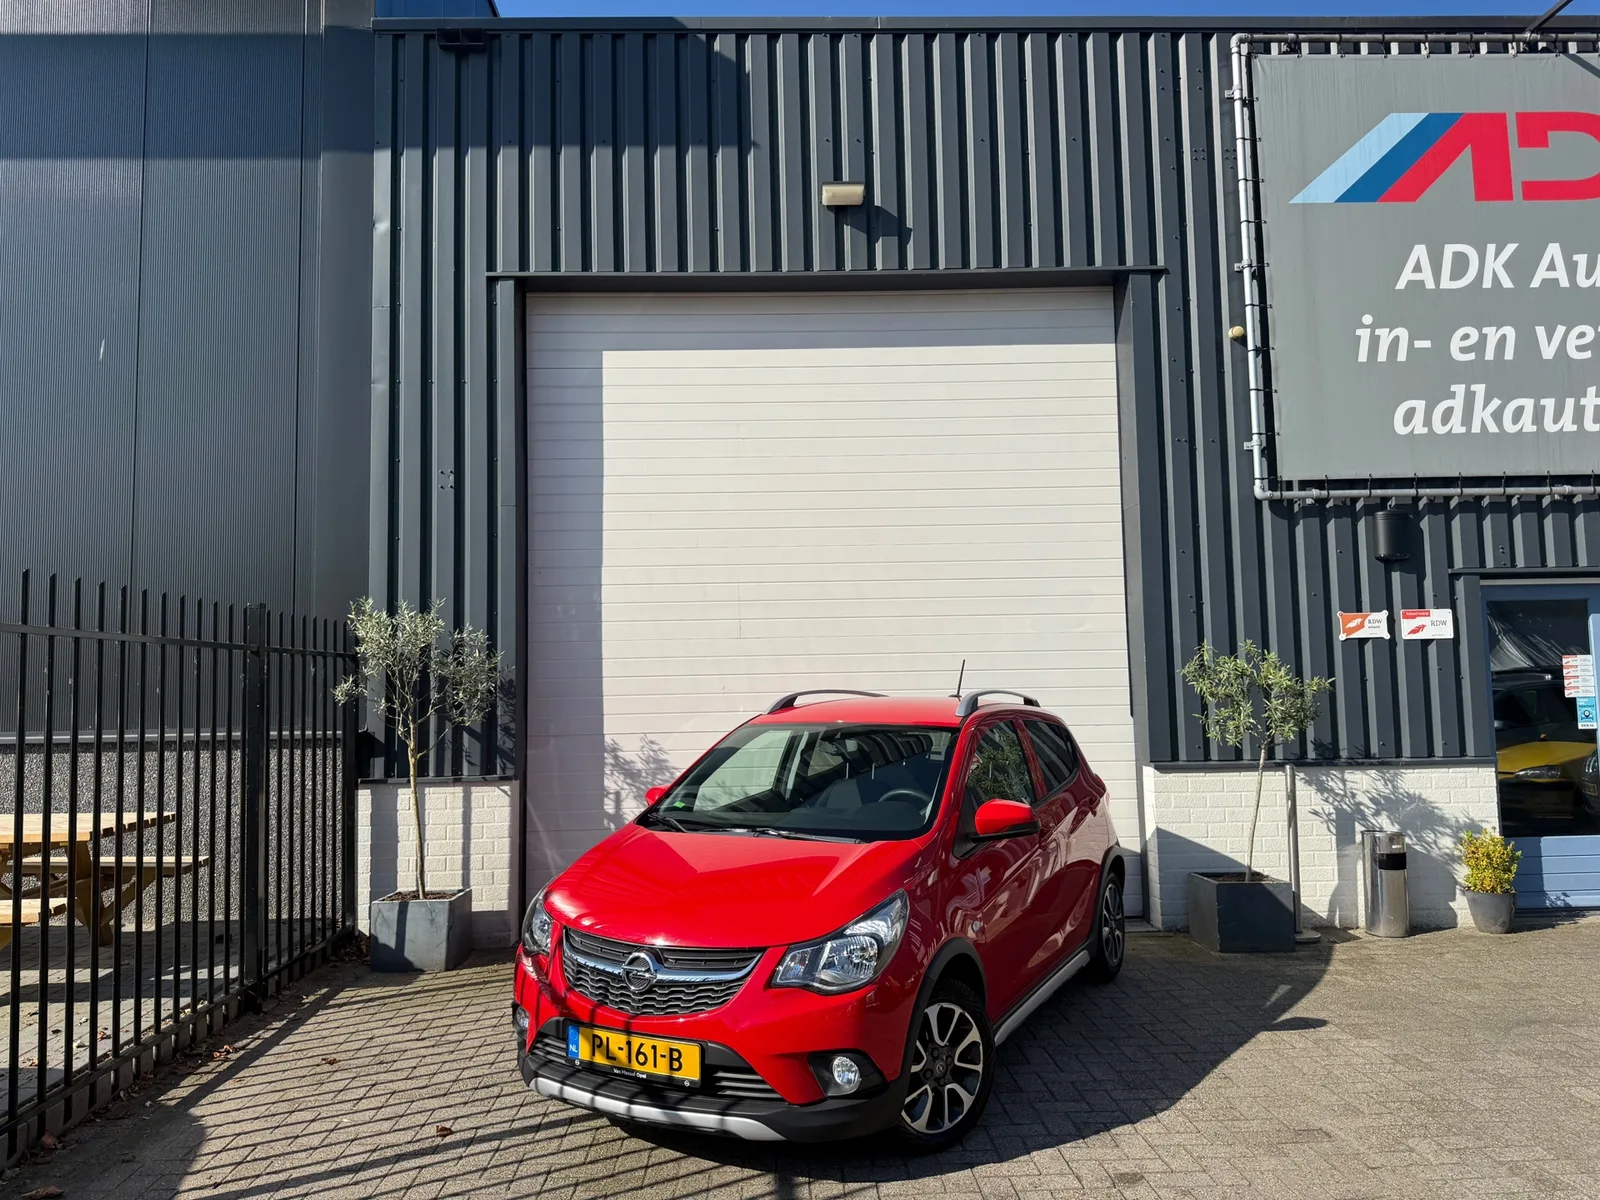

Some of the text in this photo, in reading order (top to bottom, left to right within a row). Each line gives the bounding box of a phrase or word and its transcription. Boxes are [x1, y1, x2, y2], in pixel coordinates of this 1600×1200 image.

[1395, 242, 1600, 290] ADK Au
[1355, 314, 1600, 362] in- en ve
[1393, 383, 1600, 435] adkaut
[1430, 619, 1448, 627] RDW
[569, 1033, 684, 1073] NL PL-161-B
